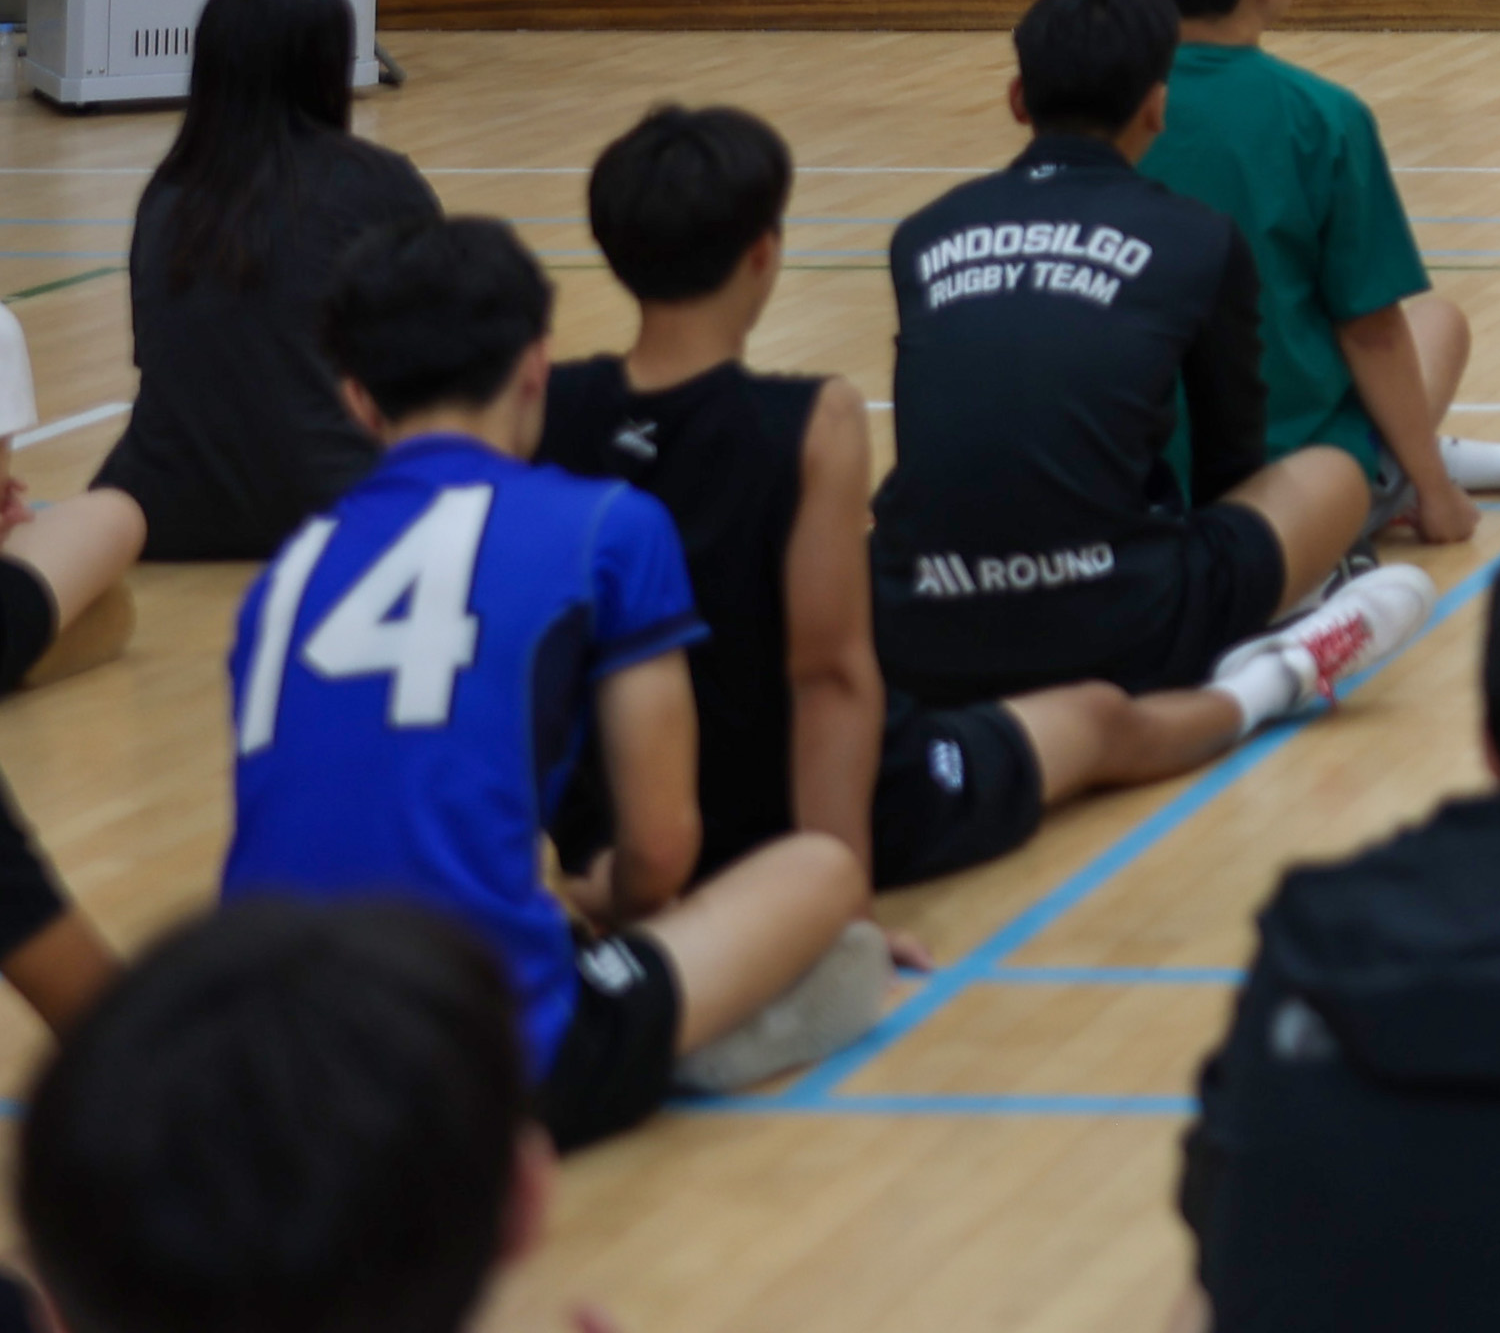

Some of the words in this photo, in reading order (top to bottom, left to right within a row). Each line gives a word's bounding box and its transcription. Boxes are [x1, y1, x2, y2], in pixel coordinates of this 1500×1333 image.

[928, 262, 1026, 309] RUGBY
[1032, 261, 1121, 307] TEAM
[238, 481, 494, 757] 14
